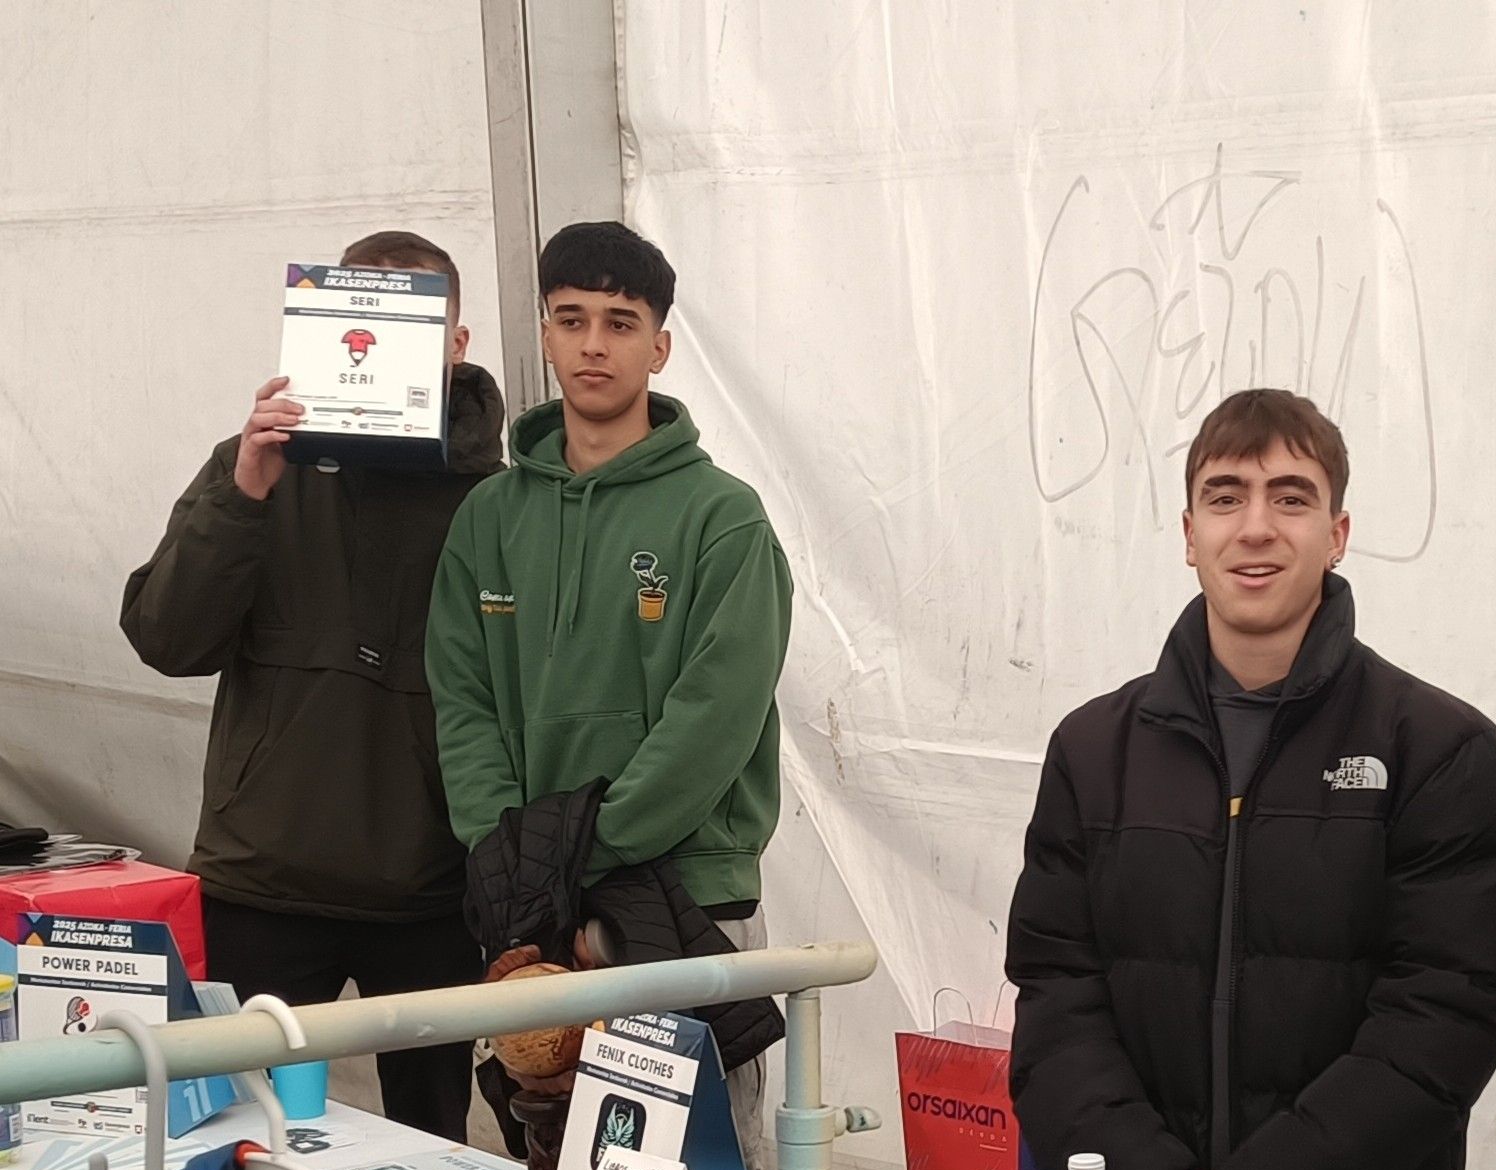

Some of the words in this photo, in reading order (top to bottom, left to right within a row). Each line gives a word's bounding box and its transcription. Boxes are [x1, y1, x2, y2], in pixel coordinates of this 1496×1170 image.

[350, 296, 380, 307] SERI
[339, 372, 374, 385] SERI
[1338, 757, 1365, 768] THE
[1330, 778, 1363, 791] FACE
[53, 920, 76, 931] 2025
[50, 930, 133, 948] IKASENPRESA
[42, 956, 90, 972] POWER
[96, 960, 138, 976] PADEL
[611, 1017, 676, 1048] IKASENPRESA
[596, 1043, 624, 1065] FENIX
[627, 1053, 674, 1080] CLOTHES
[907, 1092, 1006, 1130] orsaixan
